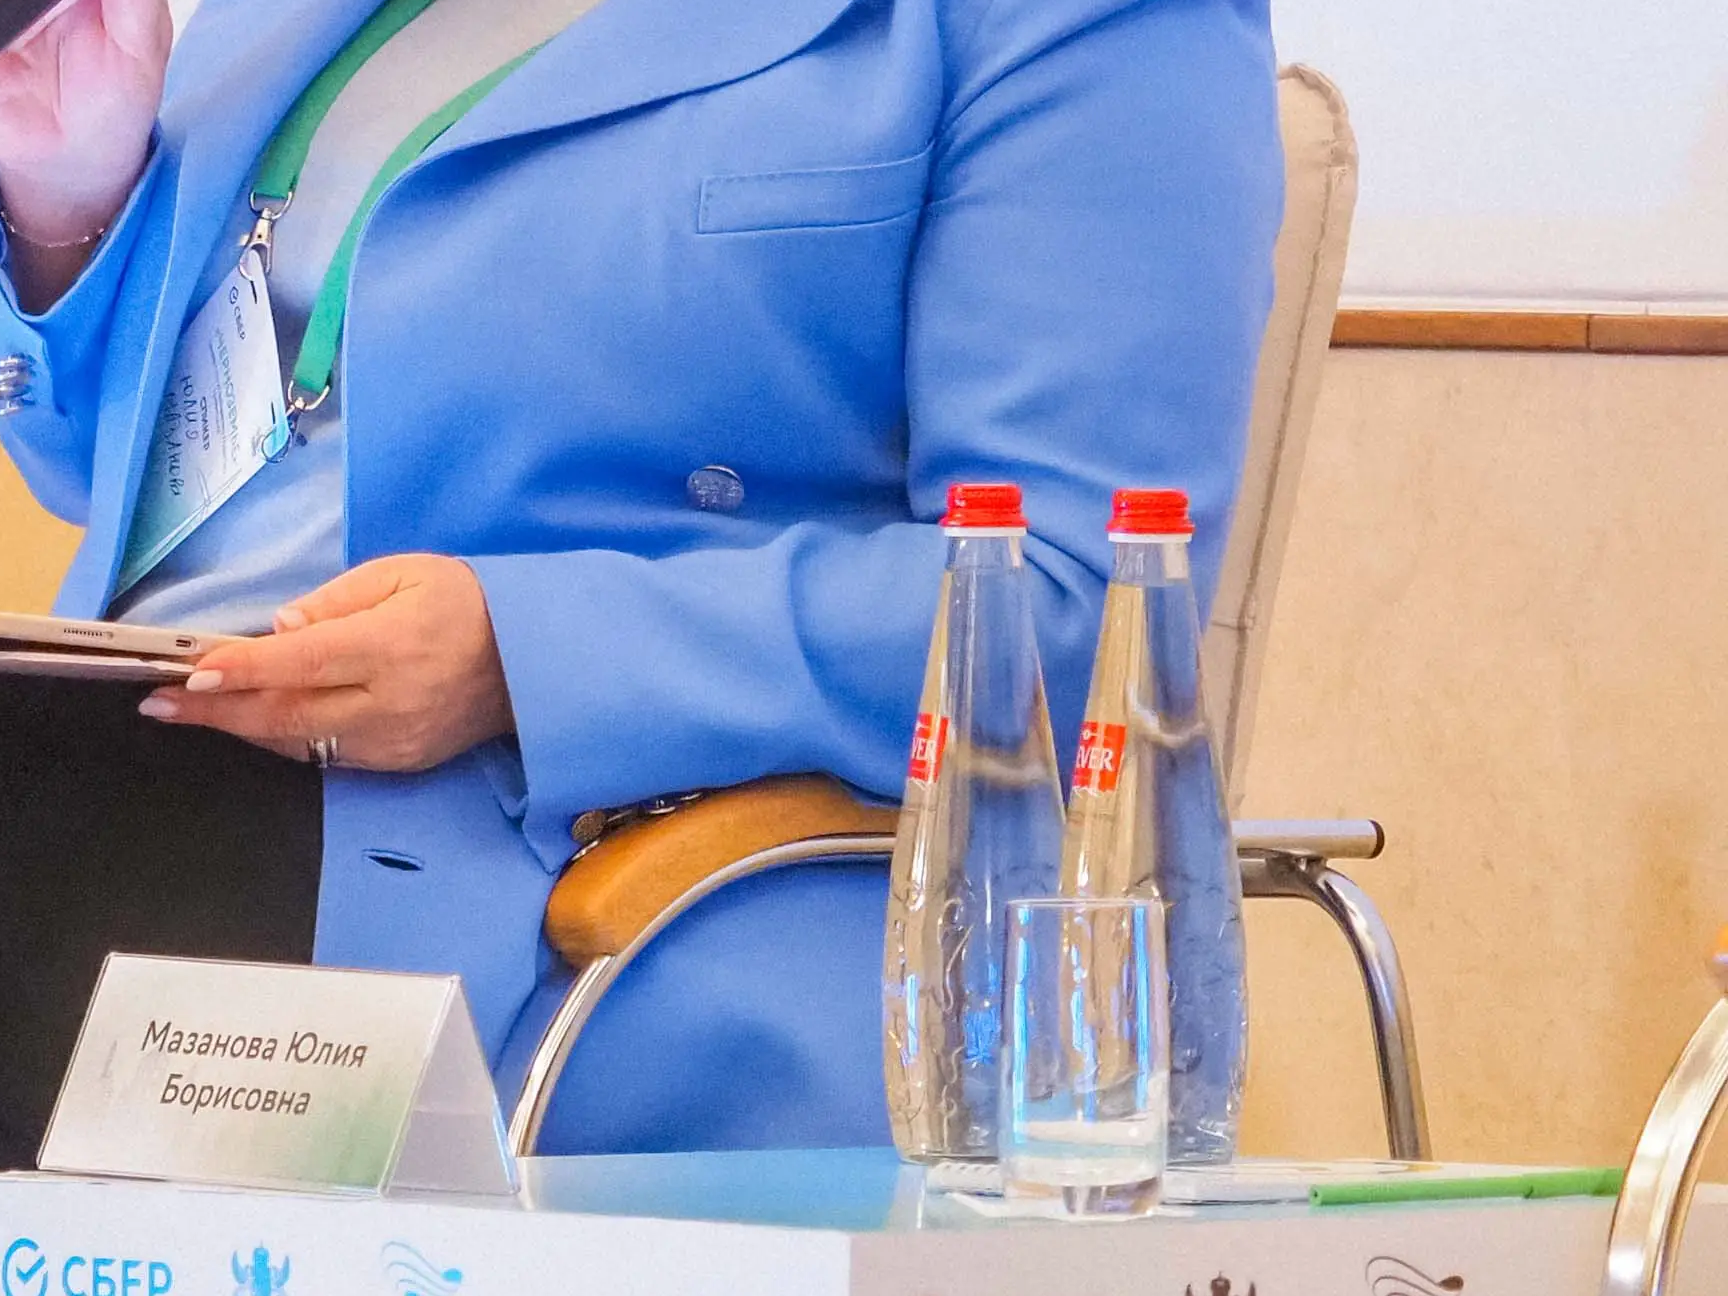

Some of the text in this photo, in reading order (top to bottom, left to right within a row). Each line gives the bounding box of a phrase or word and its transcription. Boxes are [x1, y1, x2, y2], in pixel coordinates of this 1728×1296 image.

[141, 1019, 368, 1068] Мазанова Юлия
[160, 1073, 311, 1116] Борисовна
